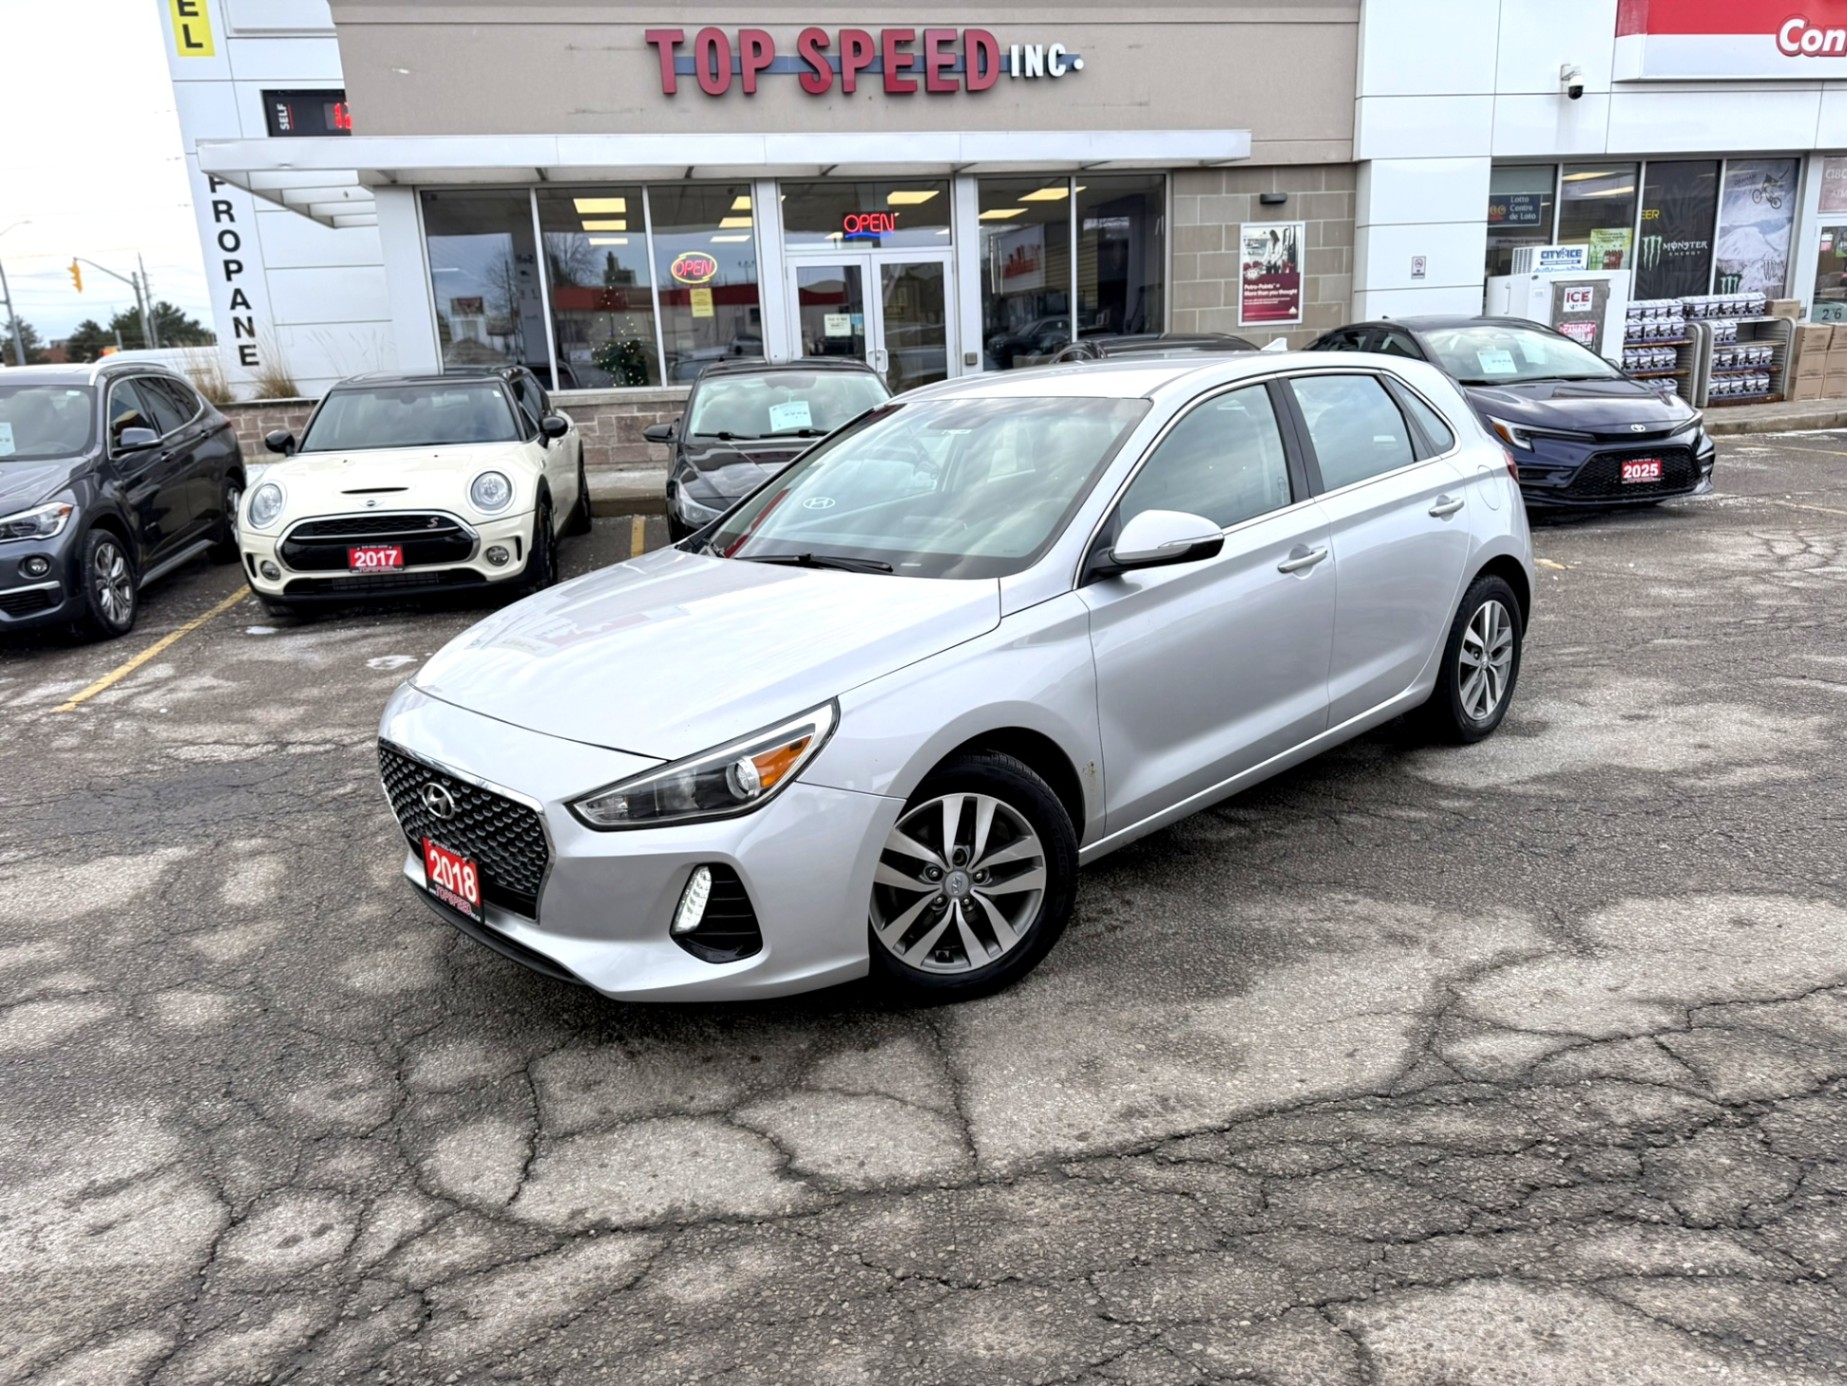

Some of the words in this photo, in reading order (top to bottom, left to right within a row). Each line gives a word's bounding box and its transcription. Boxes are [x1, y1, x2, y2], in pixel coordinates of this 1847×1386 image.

[1779, 18, 1847, 53] Con
[645, 27, 776, 95] TOP
[797, 27, 1001, 95] SPEED
[1010, 42, 1085, 78] INC.
[276, 103, 291, 131] SELF
[1509, 204, 1534, 212] Centre
[1509, 212, 1519, 220] de
[1520, 212, 1537, 220] Loto
[844, 213, 895, 233] OPEN
[1541, 250, 1560, 259] CITY
[1566, 249, 1582, 259] ICE
[1662, 240, 1709, 251] MONSTER
[208, 174, 260, 367] PROPANE
[673, 259, 713, 276] OPEN
[1566, 291, 1591, 303] ICE
[1623, 463, 1659, 478] 2025
[354, 550, 398, 567] 2017
[430, 849, 477, 903] 2018
